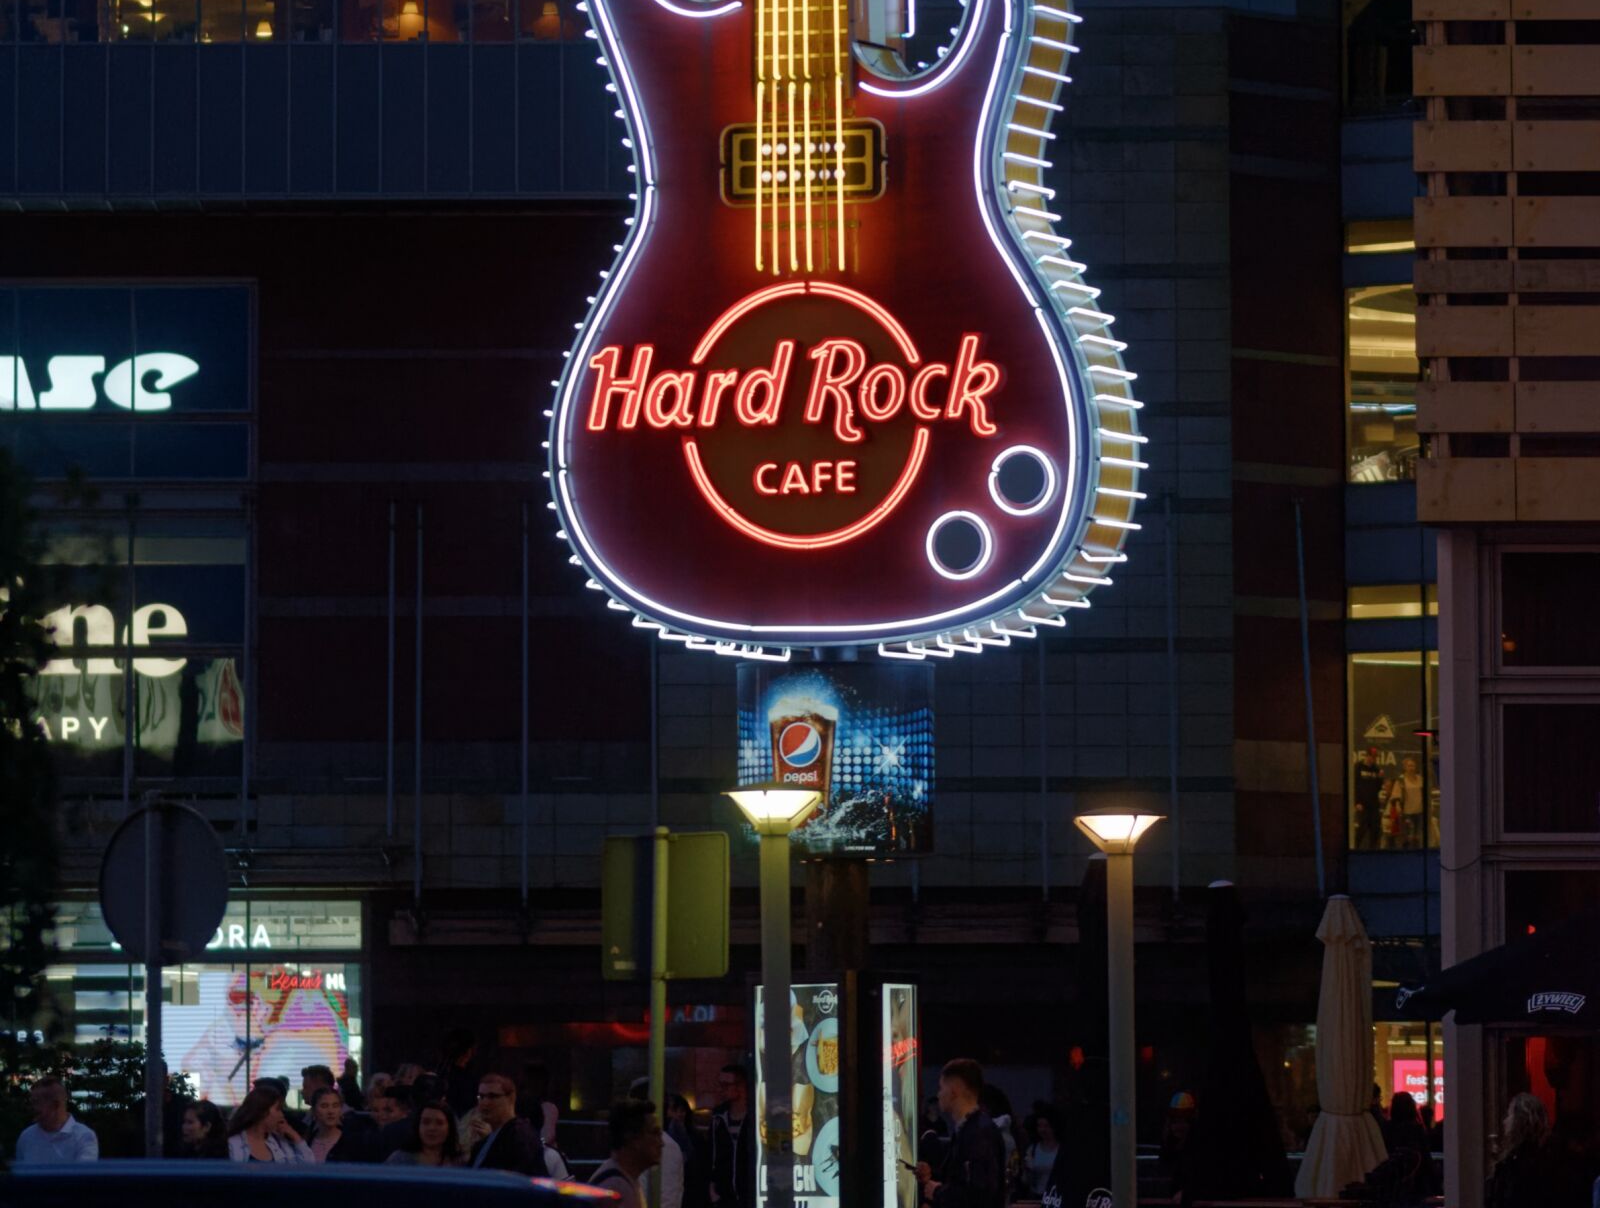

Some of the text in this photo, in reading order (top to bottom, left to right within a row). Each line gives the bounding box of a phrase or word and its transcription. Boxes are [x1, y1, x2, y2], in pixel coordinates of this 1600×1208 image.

[586, 332, 1001, 442] Hard Rock
[755, 460, 857, 494] CAFE
[783, 770, 818, 784] pepsi
[760, 1164, 817, 1192] LCH
